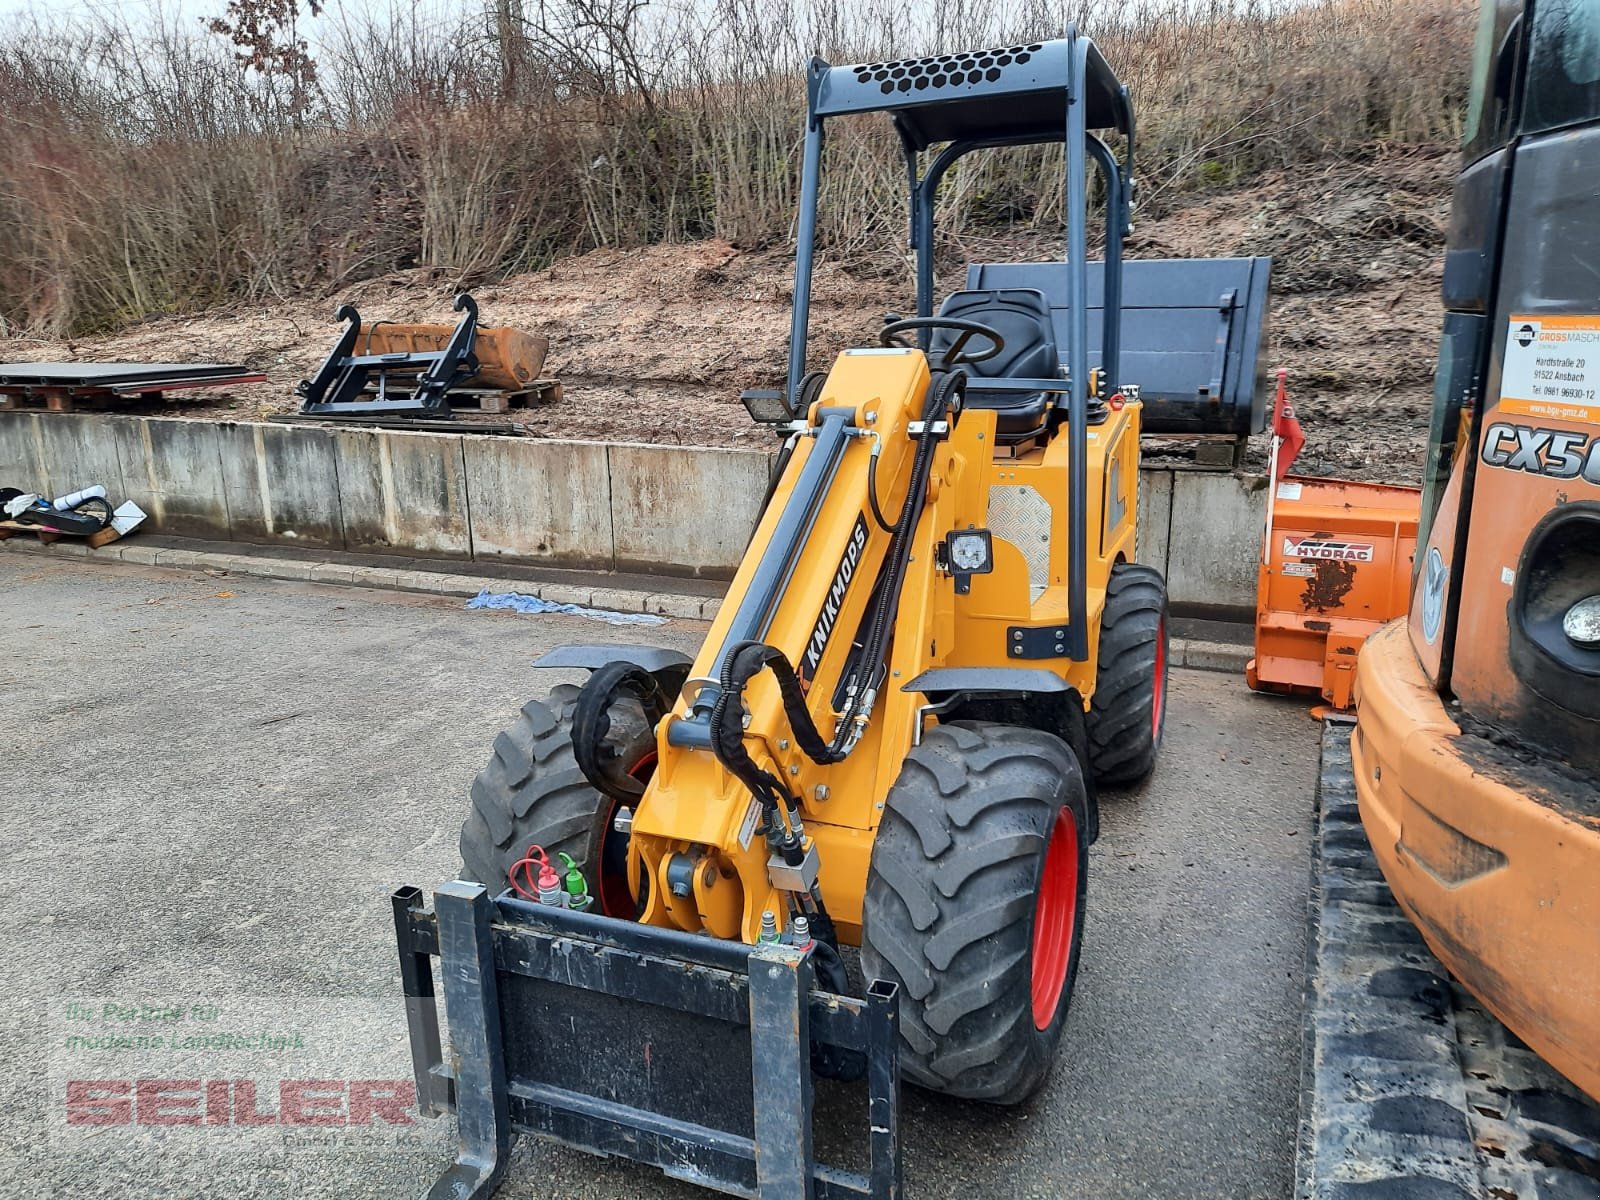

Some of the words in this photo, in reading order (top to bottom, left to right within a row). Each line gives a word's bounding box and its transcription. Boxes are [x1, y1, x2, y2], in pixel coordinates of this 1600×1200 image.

[1575, 358, 1586, 369] 20
[1534, 370, 1554, 380] 91522
[1554, 371, 1585, 382] Ansbach
[1297, 547, 1368, 560] HYDRAC
[806, 523, 866, 670] KNIKMOPS
